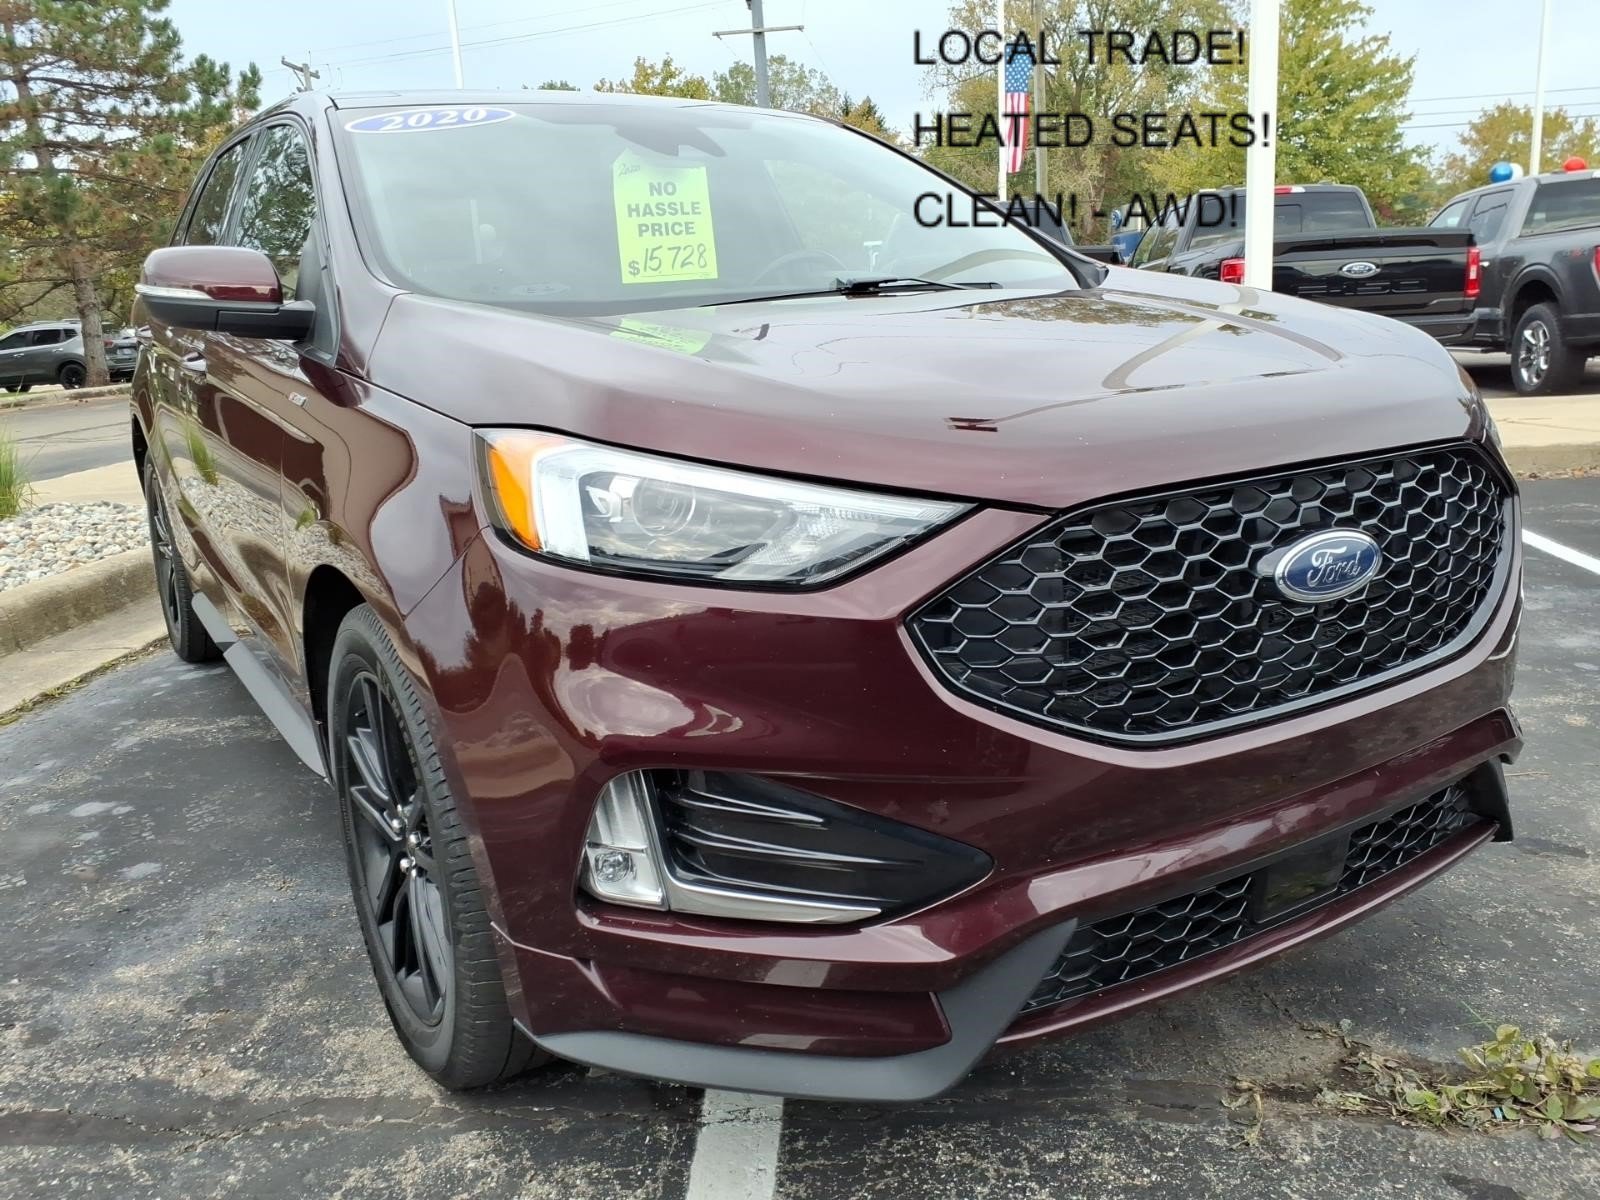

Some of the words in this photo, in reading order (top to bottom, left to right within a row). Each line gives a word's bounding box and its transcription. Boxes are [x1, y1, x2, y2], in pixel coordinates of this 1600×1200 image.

[379, 109, 487, 131] 2020
[648, 181, 677, 197] NO
[627, 201, 702, 218] HASSLE
[638, 222, 696, 238] PRICE
[1307, 546, 1361, 587] Ford
